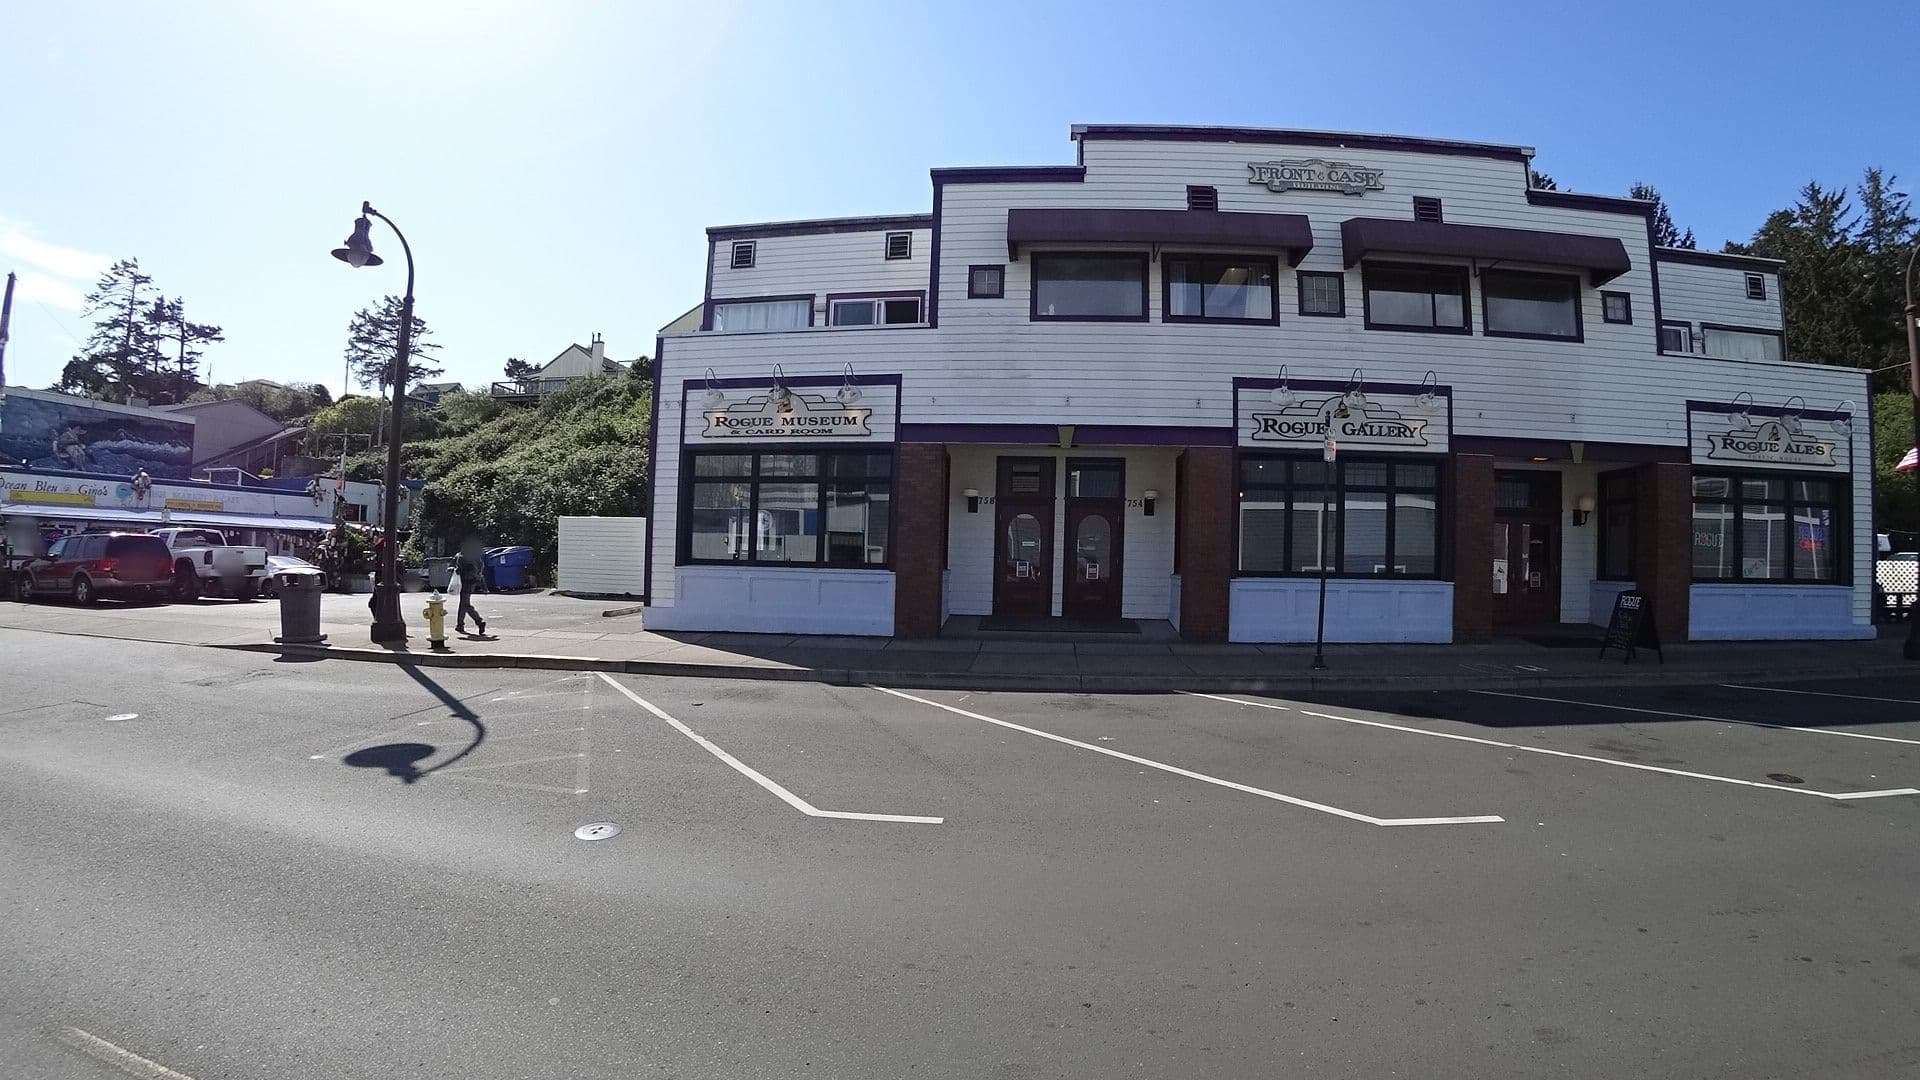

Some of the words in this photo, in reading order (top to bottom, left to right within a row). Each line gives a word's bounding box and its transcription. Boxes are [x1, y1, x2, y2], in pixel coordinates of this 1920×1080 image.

[1255, 166, 1316, 182] FRONT
[1327, 169, 1378, 187] CASE
[714, 415, 774, 430] ROGUE
[781, 415, 858, 427] MUSEUM
[1262, 417, 1327, 438] ROGUE
[1341, 421, 1419, 438] GALLERY
[1721, 438, 1780, 454] ROGUE
[1783, 442, 1826, 456] ALES
[34, 480, 58, 493] Bleu
[78, 484, 108, 497] Gino's
[978, 496, 995, 505] 758
[1127, 499, 1143, 508] 754
